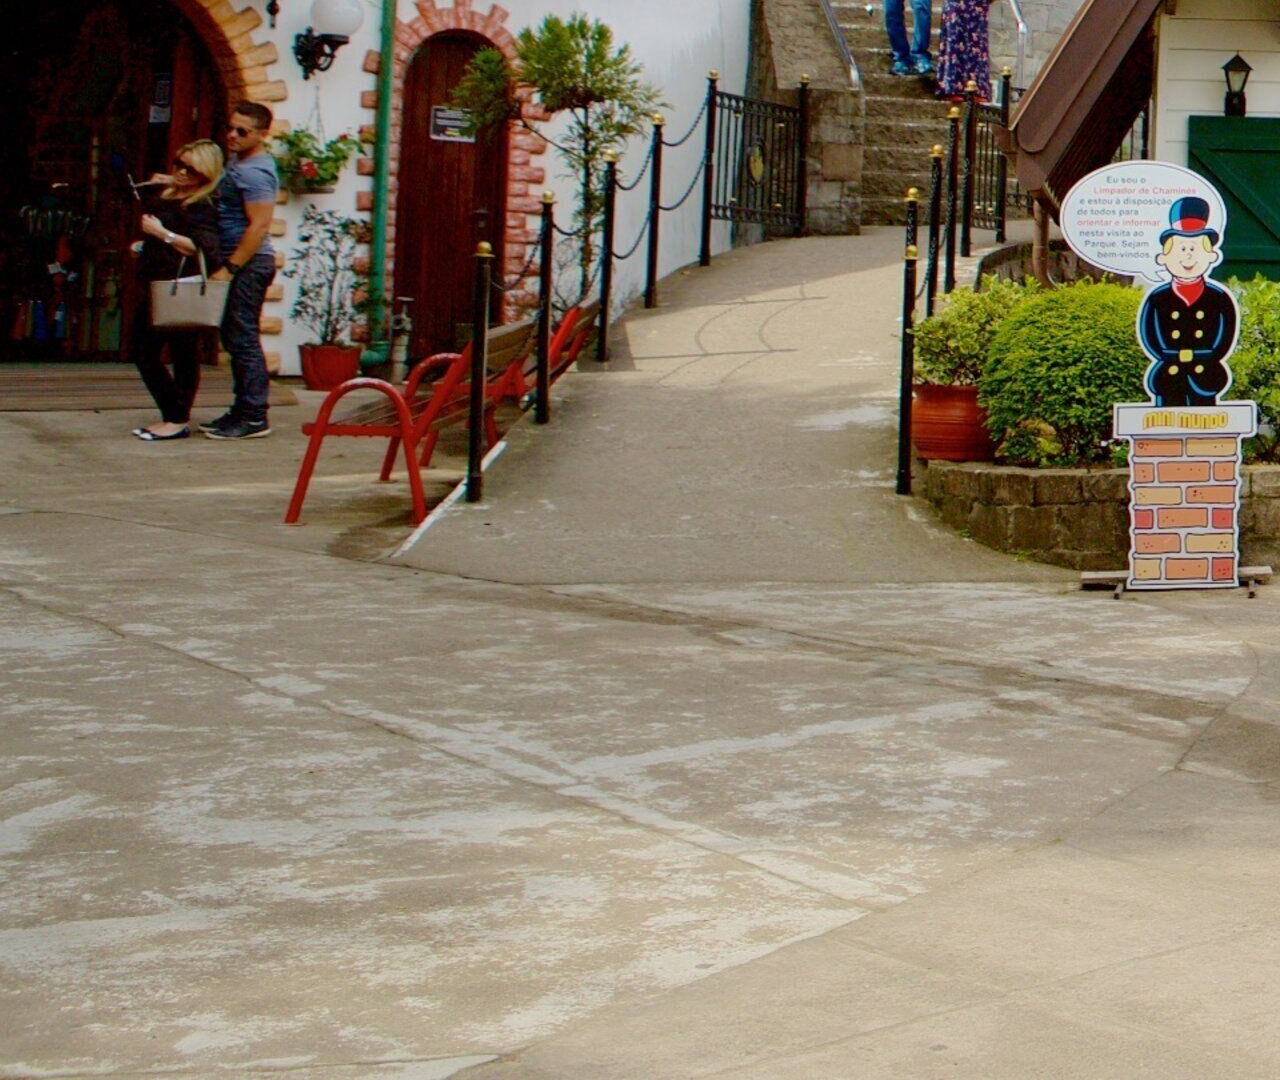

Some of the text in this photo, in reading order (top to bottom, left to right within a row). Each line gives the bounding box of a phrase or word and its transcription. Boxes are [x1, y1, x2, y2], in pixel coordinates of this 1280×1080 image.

[1106, 176, 1118, 184] Eu
[1093, 187, 1136, 196] Limpador
[1077, 208, 1088, 216] de
[1090, 208, 1116, 216] todos
[1121, 240, 1149, 248] Sejam
